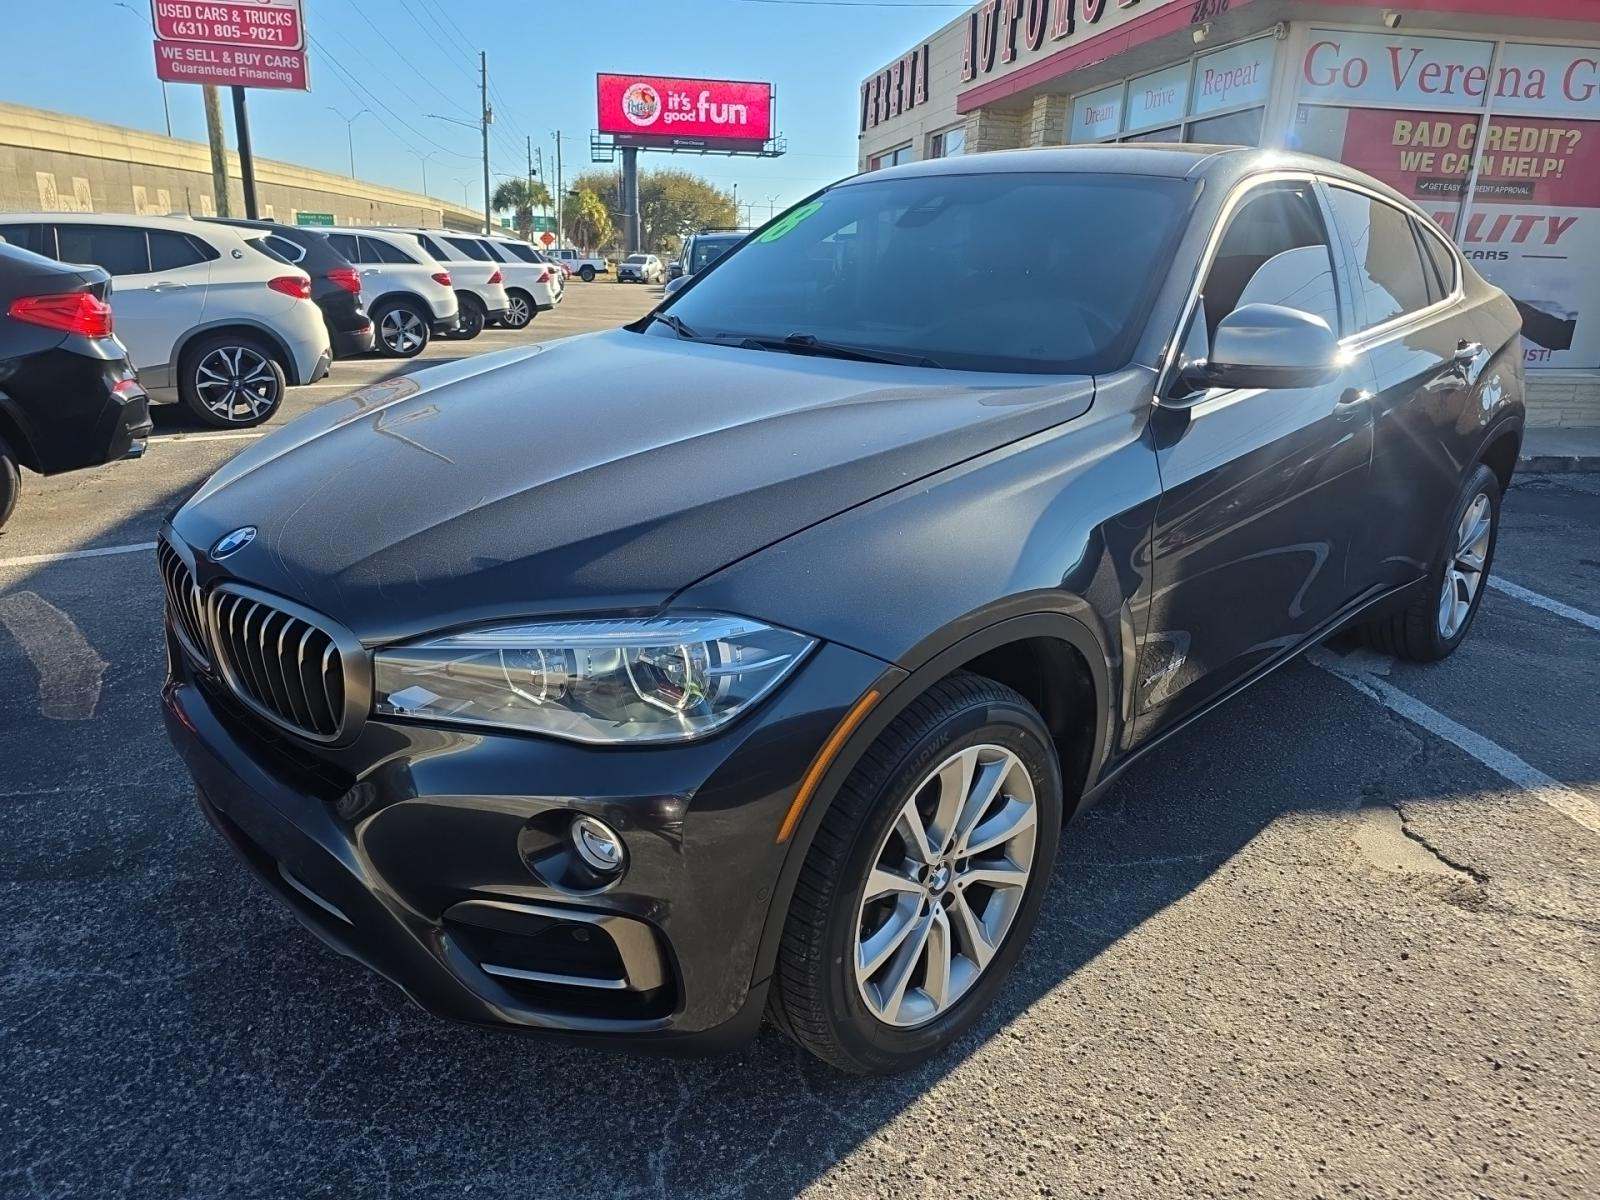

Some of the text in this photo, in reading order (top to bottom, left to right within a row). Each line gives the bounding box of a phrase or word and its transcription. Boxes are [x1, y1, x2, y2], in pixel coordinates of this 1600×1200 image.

[158, 3, 292, 27] USED CARS & TRUCKS
[172, 22, 283, 42] (631) 805-9021
[161, 46, 300, 69] WE SELL & BUY CARS
[172, 62, 293, 83] Guaranteed Financing
[1201, 60, 1262, 102] Repeat
[1304, 40, 1600, 102] Go Verena G
[667, 90, 748, 125] it's fun
[1143, 87, 1175, 111] Drive
[664, 111, 696, 124] good
[1084, 104, 1115, 126] Dream
[1392, 119, 1582, 155] BAD CREDIT?
[1400, 150, 1565, 179] WE CAN HELP!
[1428, 182, 1529, 195] GET EASY REDIT APPROVAL
